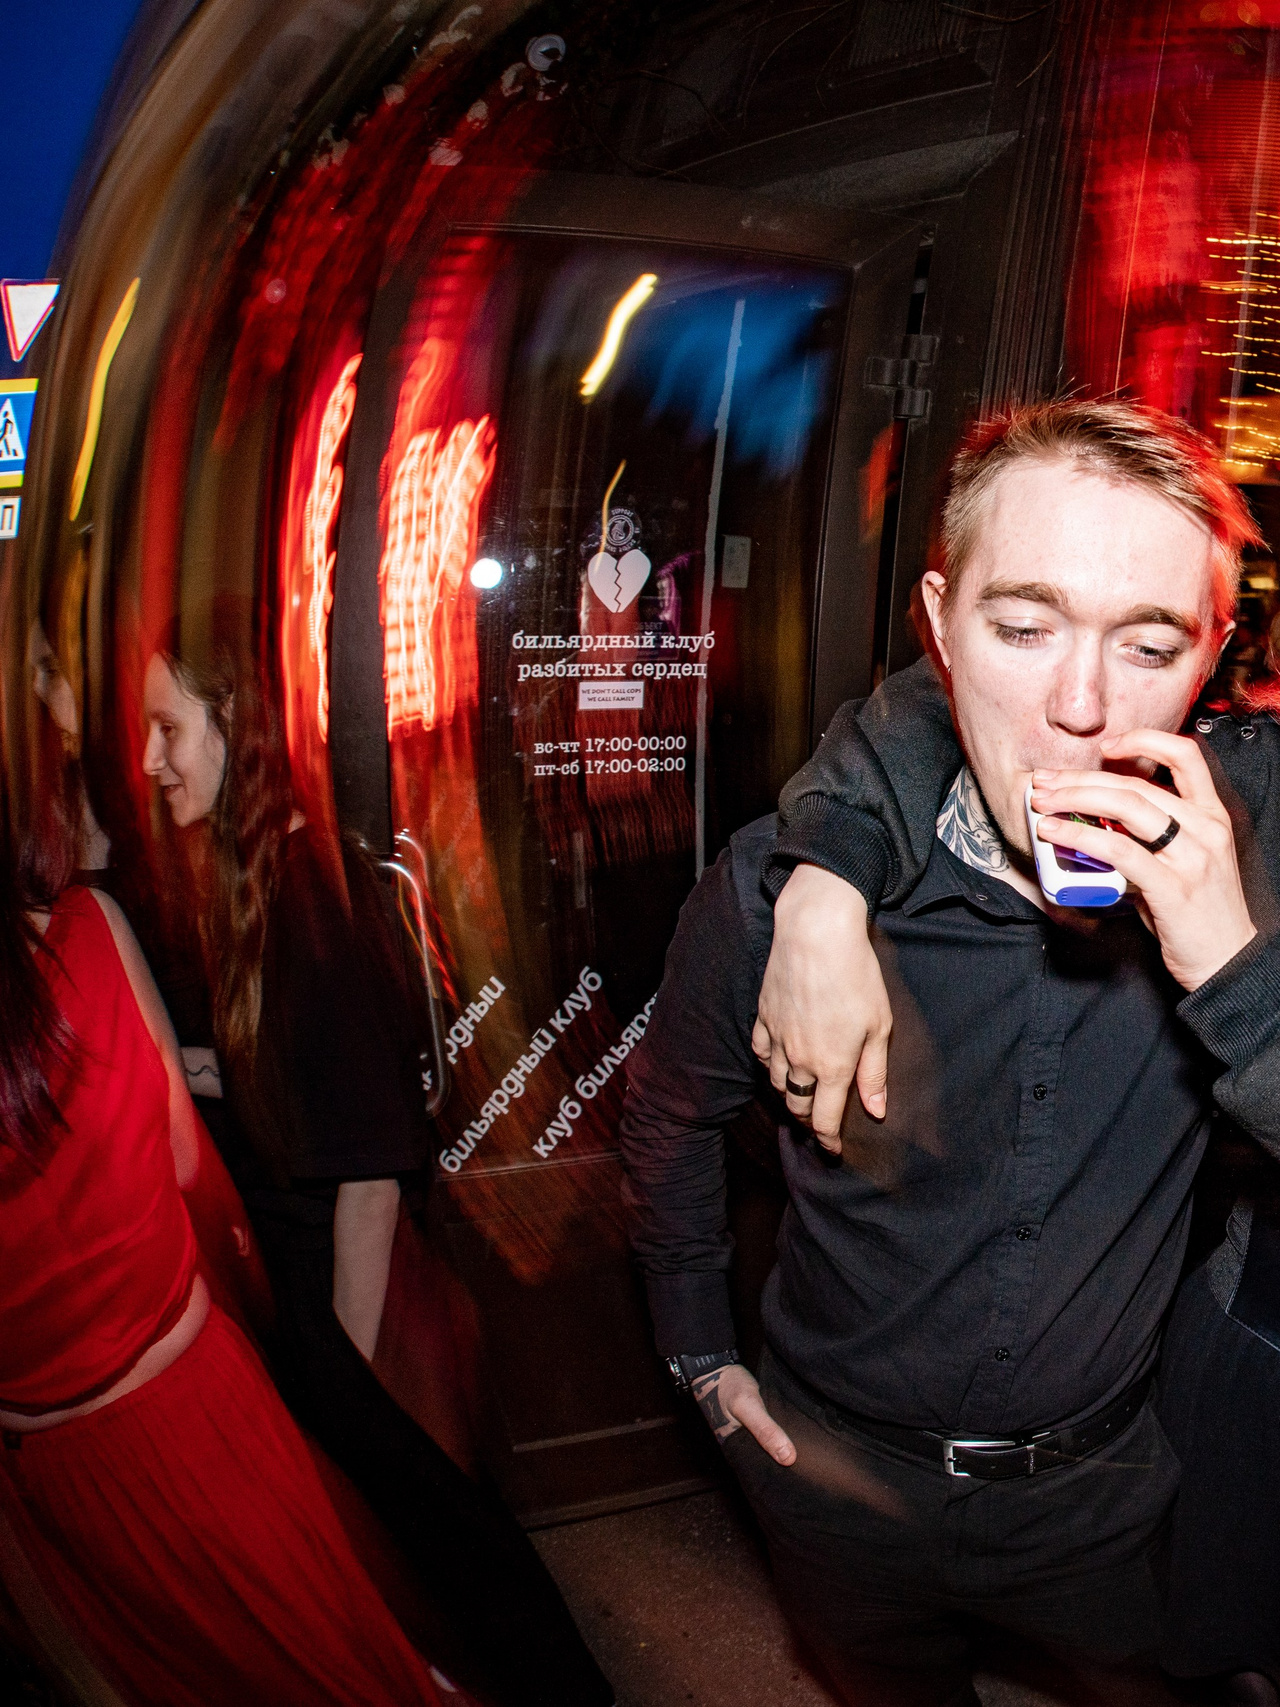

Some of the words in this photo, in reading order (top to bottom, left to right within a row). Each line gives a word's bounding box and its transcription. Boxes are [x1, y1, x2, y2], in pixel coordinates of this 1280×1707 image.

[512, 629, 656, 653] бильярдный
[660, 629, 716, 653] клуб
[517, 657, 627, 682] разбитых
[631, 661, 708, 681] сердец
[533, 741, 581, 755] вс-чт
[584, 735, 688, 754] 17:00-00:00
[533, 759, 581, 777] пт-сб
[584, 757, 687, 775] 17:00-02:00
[438, 1027, 558, 1173] бильярдный
[548, 965, 603, 1034] клуб
[531, 1094, 583, 1159] клуб
